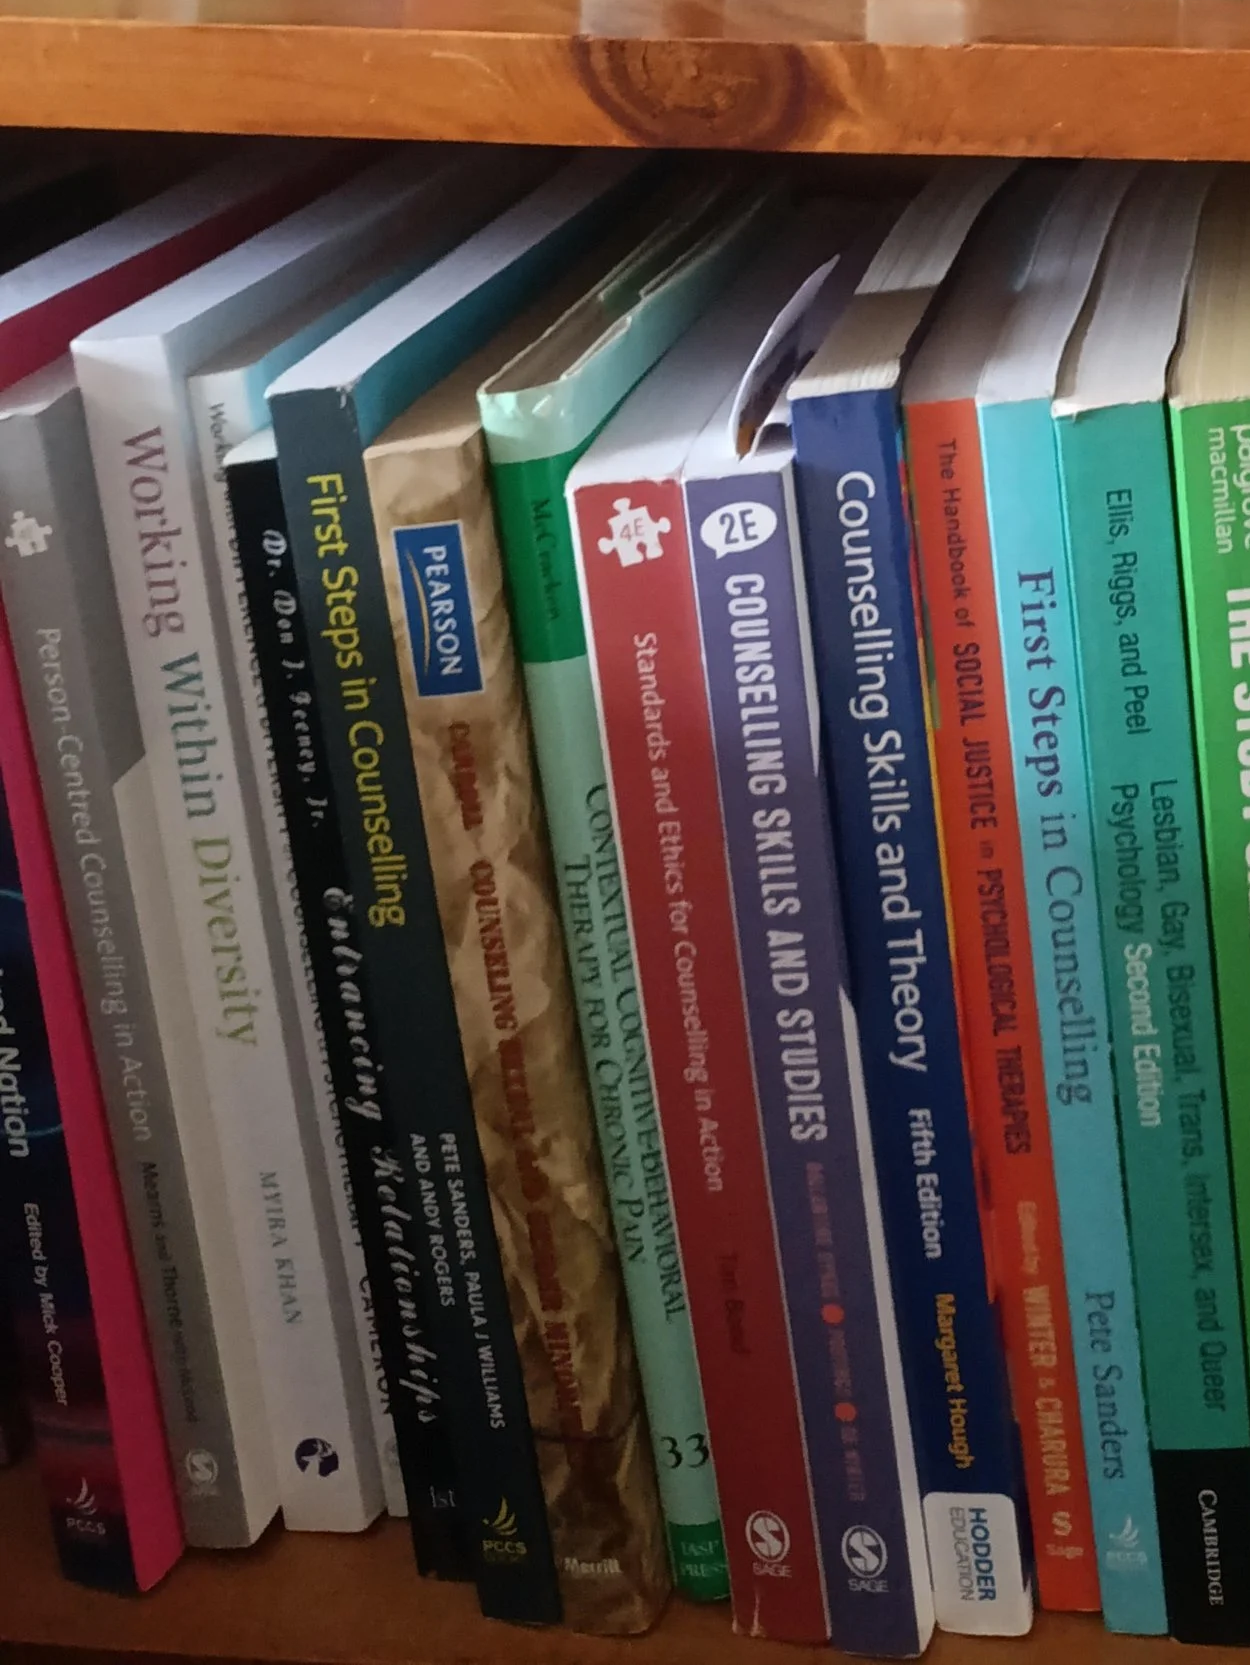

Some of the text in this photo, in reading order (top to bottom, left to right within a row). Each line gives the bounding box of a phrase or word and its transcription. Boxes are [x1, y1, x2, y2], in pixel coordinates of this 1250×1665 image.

[618, 516, 646, 542] 4E
[718, 509, 758, 546] 2E
[1207, 426, 1234, 555] macmillan
[423, 544, 464, 678] PEARSON
[122, 426, 262, 1047] Working Within Diversity
[306, 472, 408, 929] First Steps in Counselling
[835, 470, 927, 1073] Counselling Skills and Theory
[725, 573, 828, 1143] COUNSELLING SKILLS AND STUDIES
[1109, 783, 1162, 1128] Psychology Second Edition
[752, 1562, 793, 1579] SAGE
[948, 1506, 974, 1603] EDUCATION
[968, 1507, 996, 1602] HODDER
[1198, 1489, 1225, 1606] CAMBRIDGE
